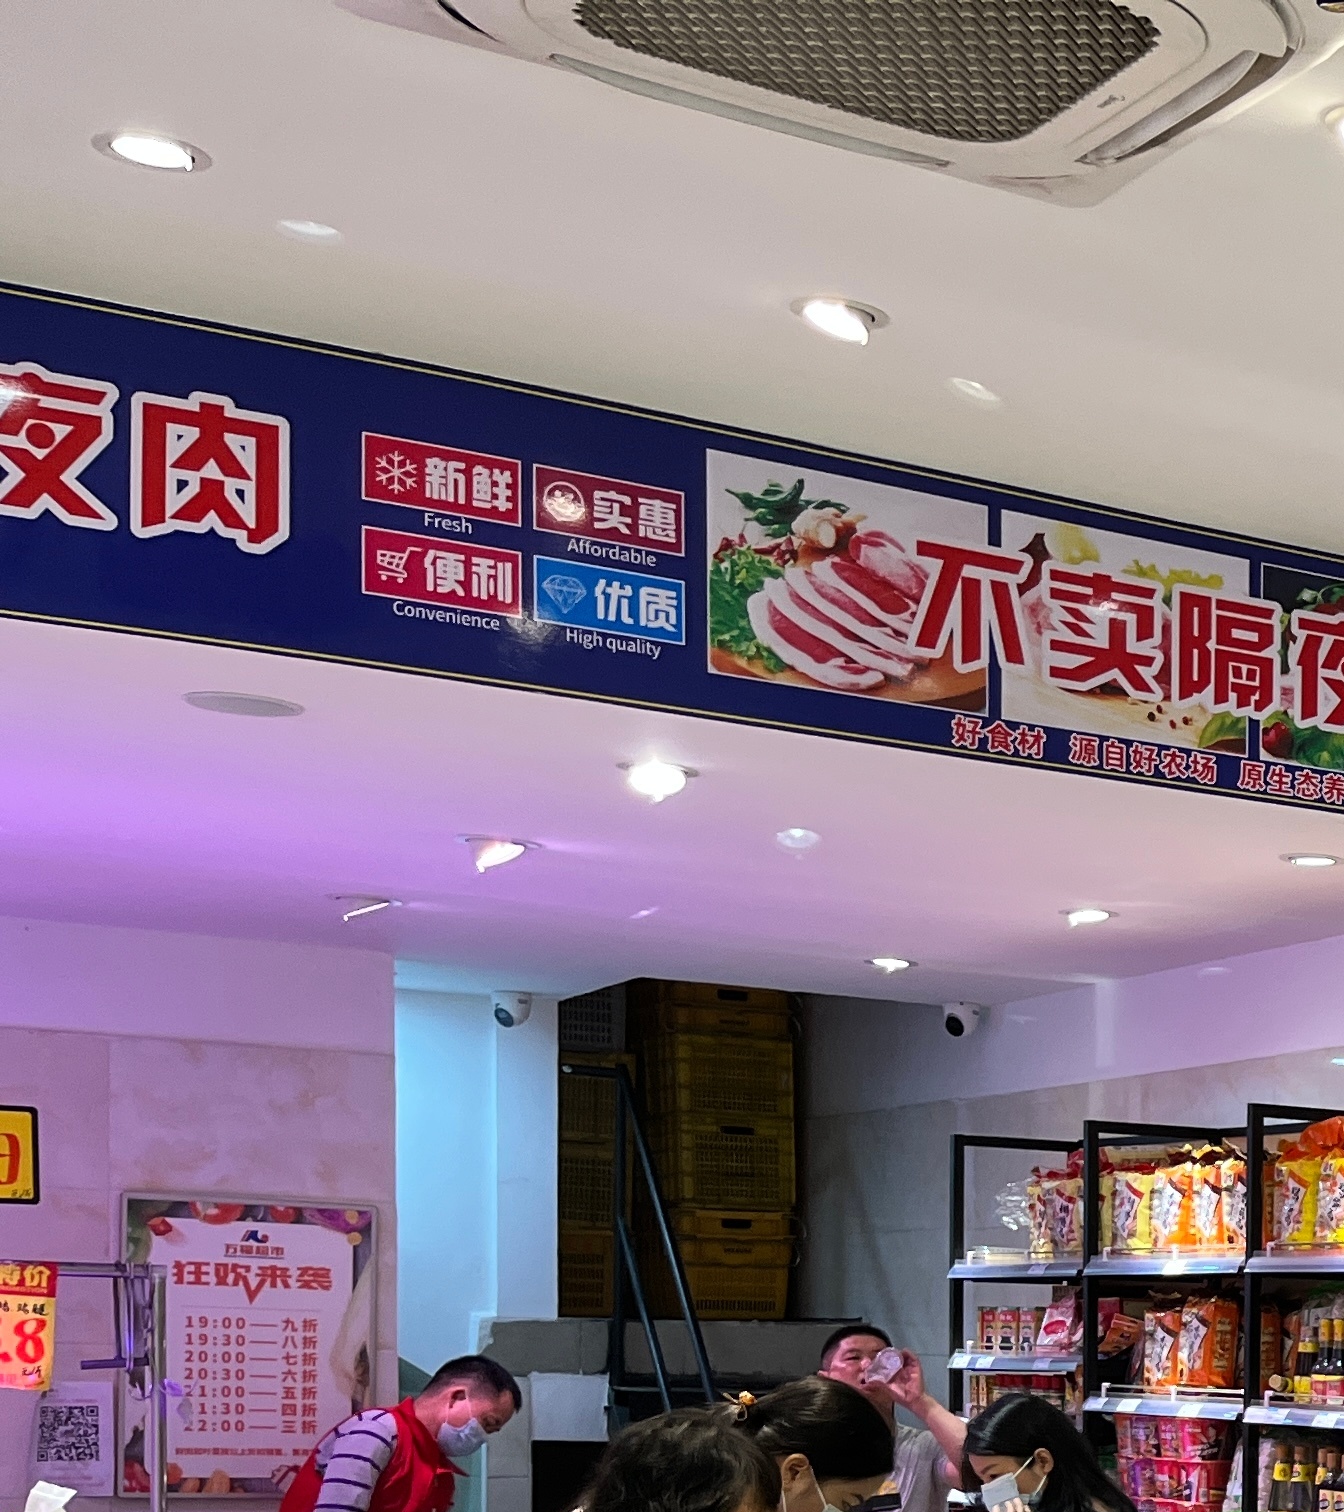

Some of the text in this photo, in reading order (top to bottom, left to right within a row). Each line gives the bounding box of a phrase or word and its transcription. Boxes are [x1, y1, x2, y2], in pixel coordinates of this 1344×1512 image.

[423, 456, 512, 512] 新鲜
[424, 512, 473, 536] Fresh
[592, 489, 678, 546] 实惠
[423, 549, 514, 606] 便利
[566, 536, 657, 569] Affordable
[392, 599, 501, 634] Convenience
[595, 580, 679, 636] 优质
[565, 626, 662, 660] High quality
[952, 716, 1045, 759] 好食材
[1068, 733, 1217, 784] 源自好农场
[172, 1260, 333, 1304] 狂欢来袭
